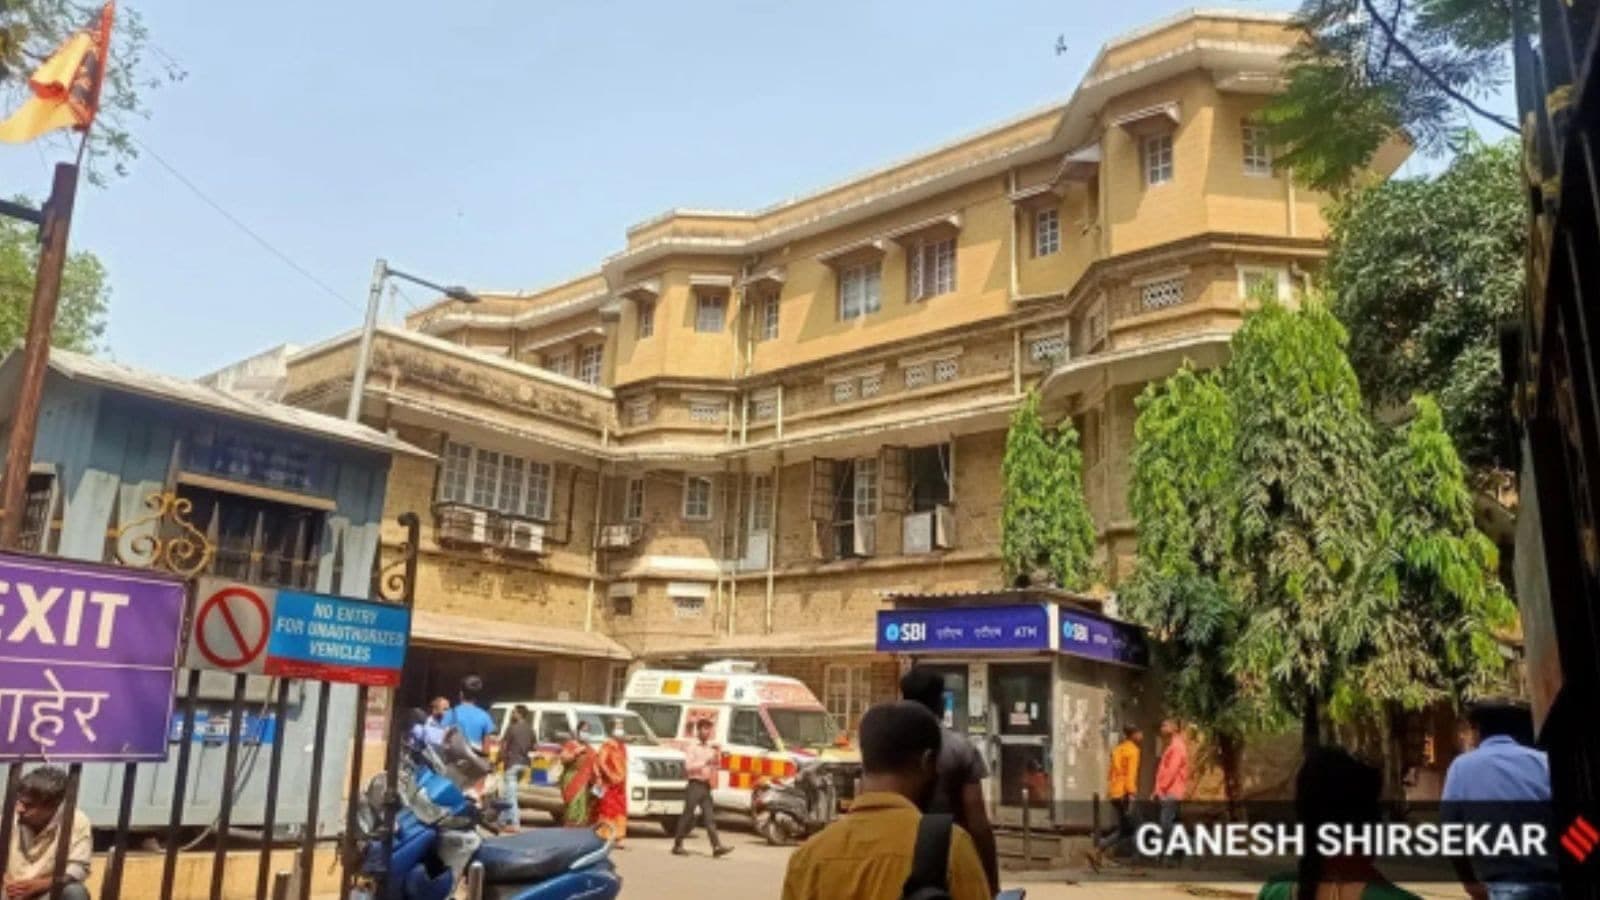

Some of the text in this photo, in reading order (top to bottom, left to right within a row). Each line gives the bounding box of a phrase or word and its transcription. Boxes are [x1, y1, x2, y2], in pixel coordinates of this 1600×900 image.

[313, 602, 378, 625] NO ENTRY
[275, 616, 406, 647] FOR UNAUTHORIZED
[901, 622, 926, 642] SBI
[1014, 625, 1038, 639] ATM
[1071, 622, 1089, 644] SBI
[309, 641, 372, 662] VEHICLES
